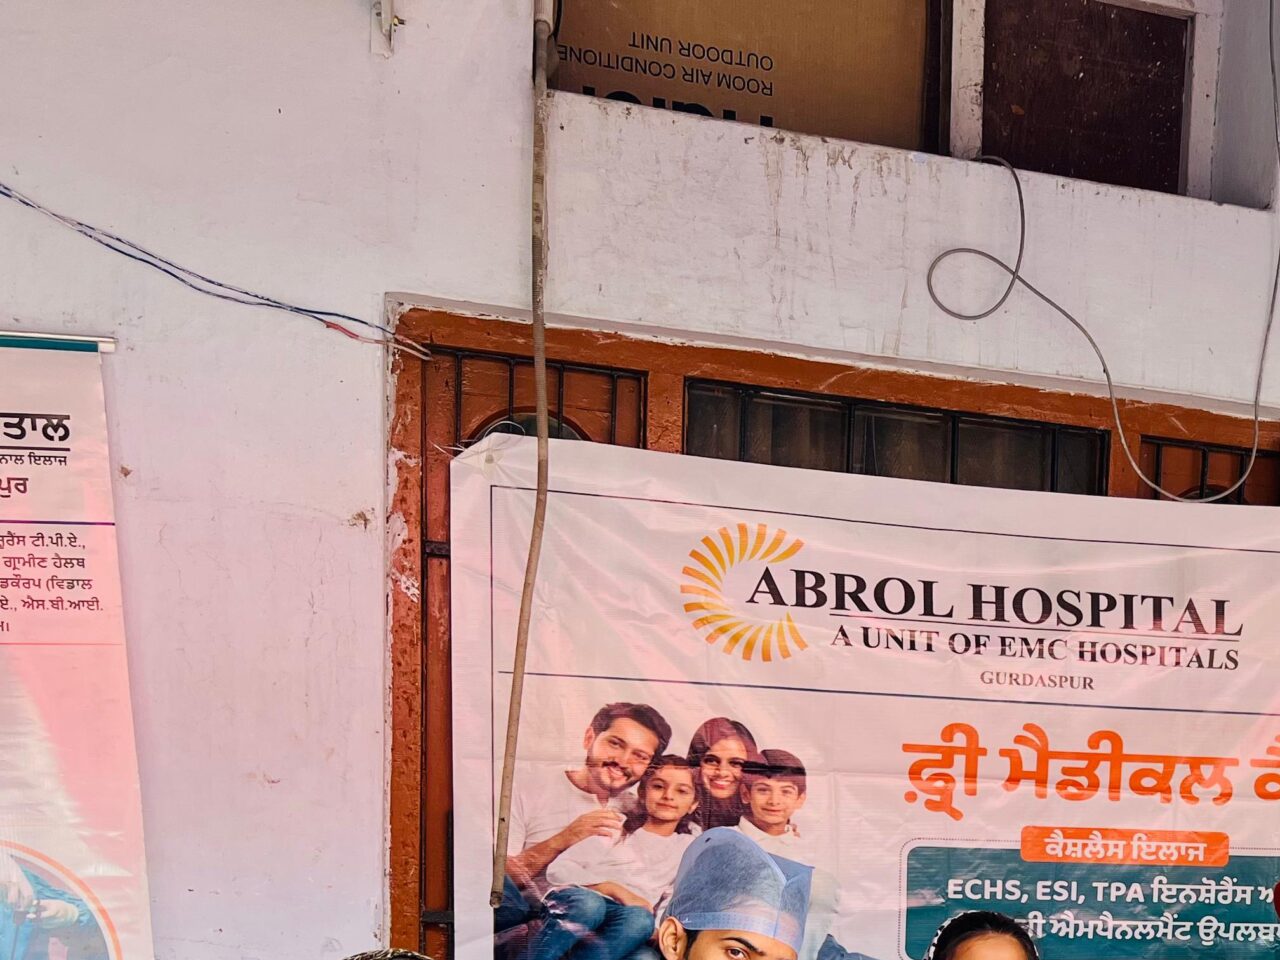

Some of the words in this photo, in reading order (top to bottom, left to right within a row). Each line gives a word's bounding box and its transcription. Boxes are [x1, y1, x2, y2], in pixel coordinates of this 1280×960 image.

[628, 32, 672, 54] UNIT
[678, 40, 773, 71] OUTDOOR
[557, 44, 676, 79] CONDITIONE
[682, 66, 712, 87] AIR
[717, 72, 773, 97] ROOM
[0, 412, 70, 441] ਤਾਲ
[28, 452, 67, 466] ਇਲਾਜ
[0, 477, 29, 498] ਪੁਰ
[2, 553, 48, 570] ਗ੍ਰਾਮੀਣ
[51, 553, 85, 568] ਹੈਲਥ
[0, 573, 41, 589] ਡਕੌਰਪ
[745, 566, 955, 621] ABROL
[966, 584, 1244, 637] HOSPITAL
[831, 625, 854, 648] A
[861, 627, 939, 653] UNIT
[948, 632, 989, 656] OF
[1000, 638, 1069, 662] EMC
[1077, 641, 1239, 670] HOSPITALS
[980, 671, 1095, 691] GURDASPUR
[999, 723, 1240, 806] ਮੈਡੀਕਲ
[1044, 831, 1127, 860] ਕੈਸ਼ਲੈਸ
[1131, 834, 1207, 862] ਇਲਾਜ
[947, 879, 1028, 904] ECHS,
[1036, 880, 1086, 905] ESI,
[1092, 882, 1145, 903] TPA
[1049, 910, 1194, 941] ਐਮਪੈਨਲਮੈਂਟ
